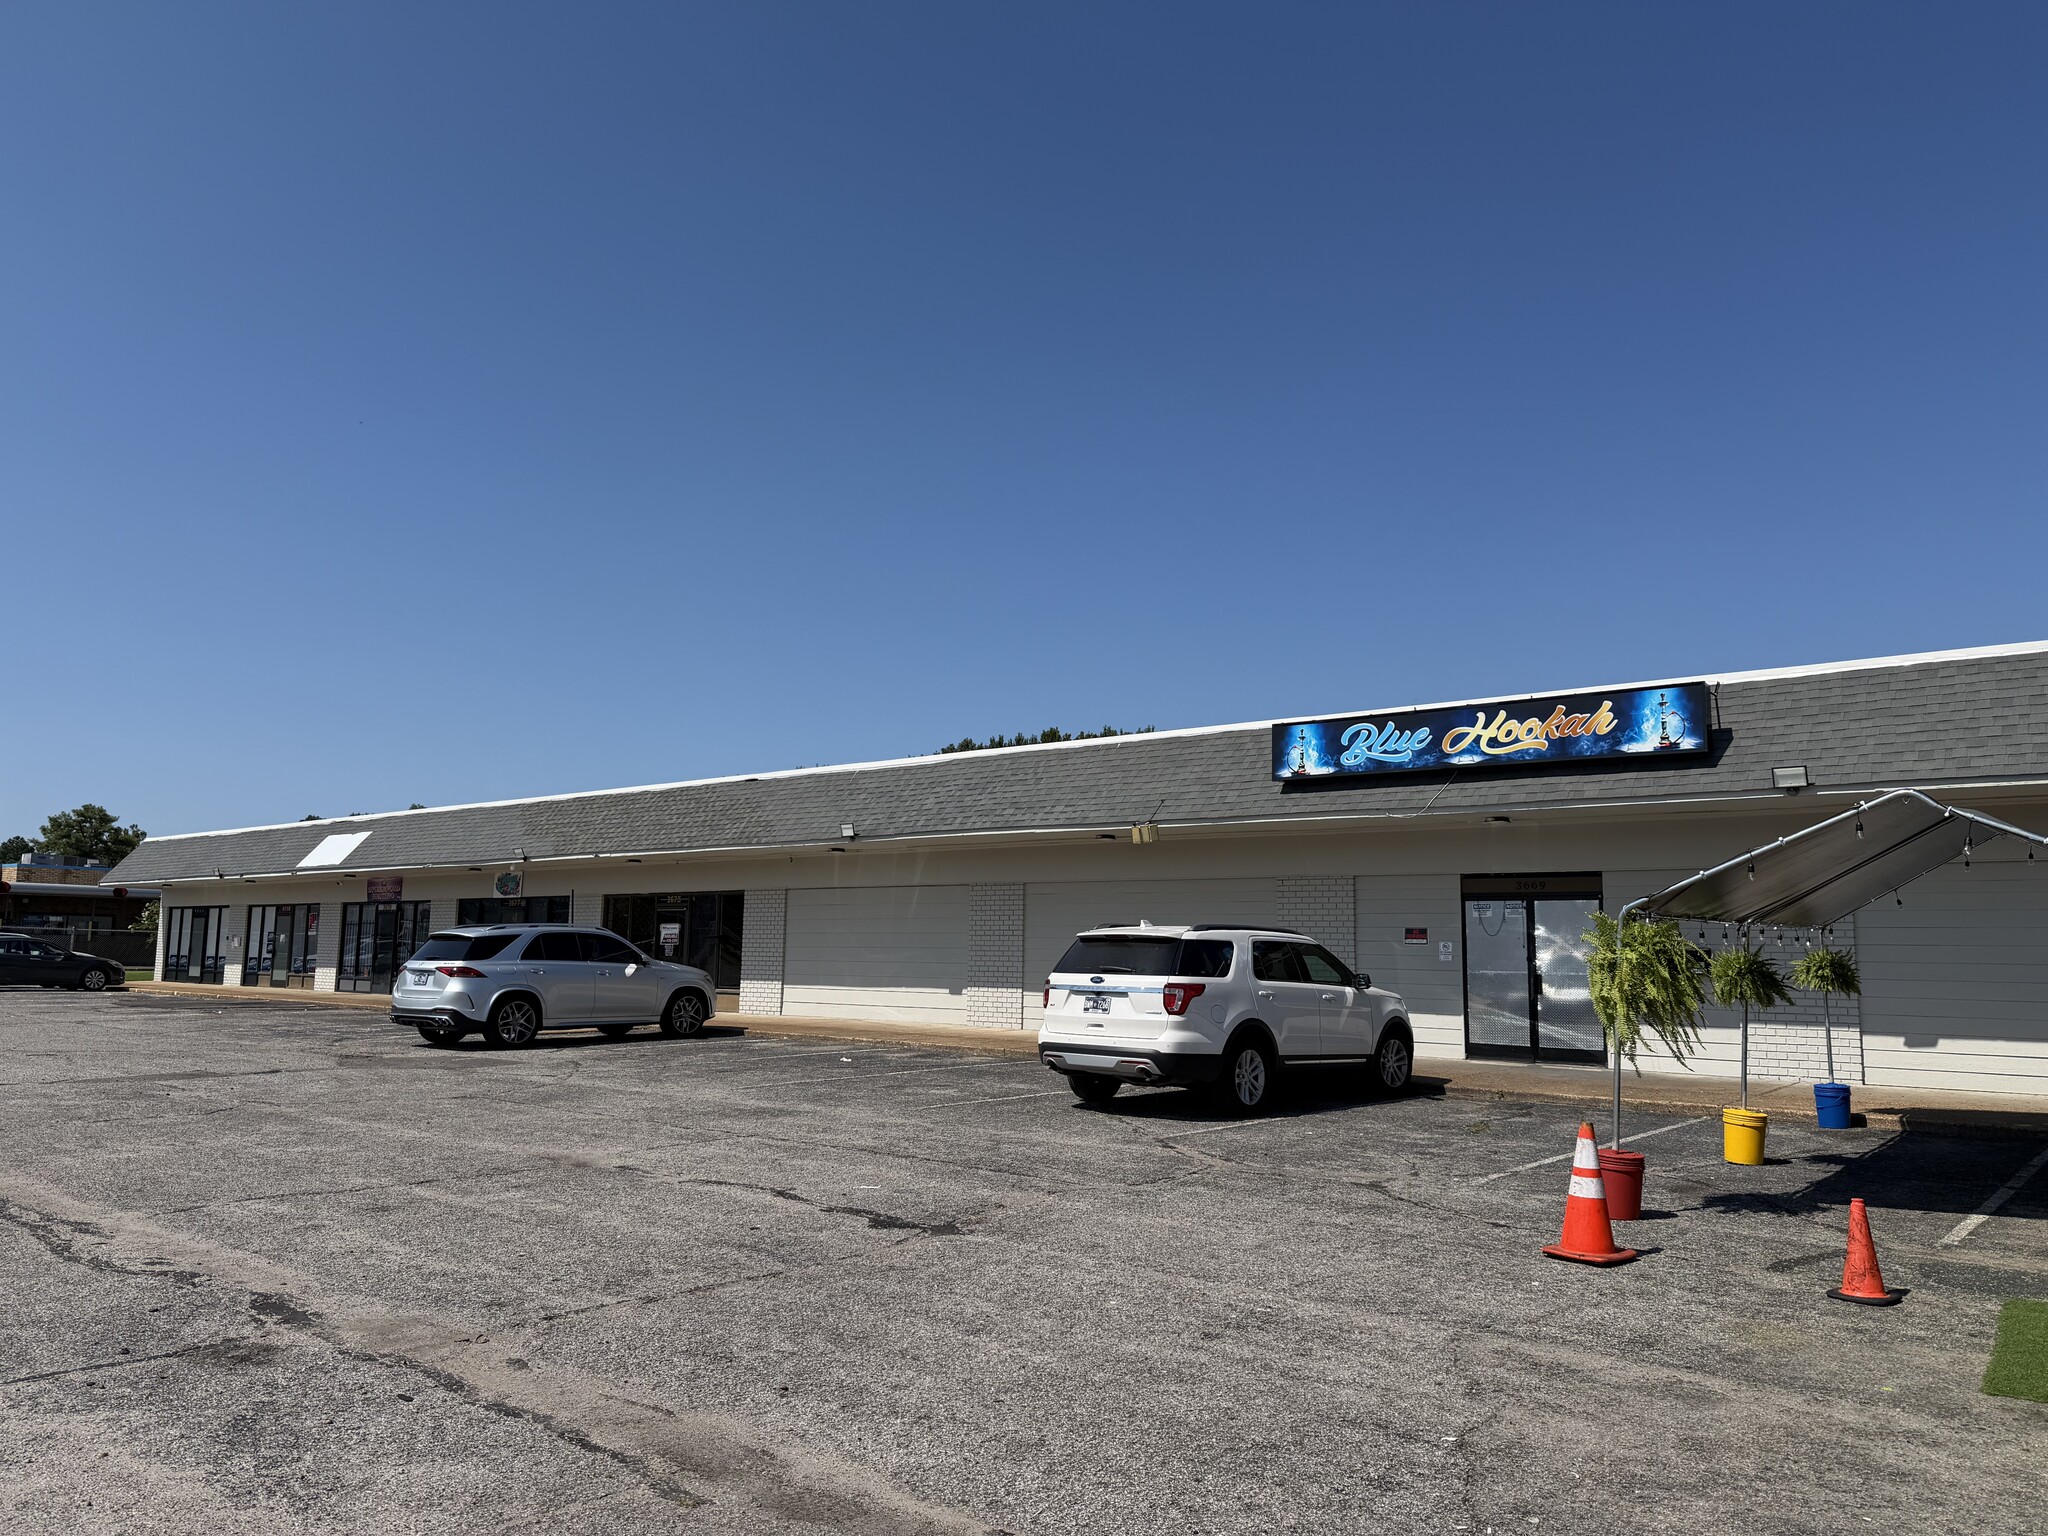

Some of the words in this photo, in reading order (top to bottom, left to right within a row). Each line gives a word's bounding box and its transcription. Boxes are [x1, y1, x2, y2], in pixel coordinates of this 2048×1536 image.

[1340, 721, 1432, 766] Blue
[1441, 700, 1618, 755] Hookah
[1515, 881, 1546, 890] 3669
[667, 895, 682, 903] 3675
